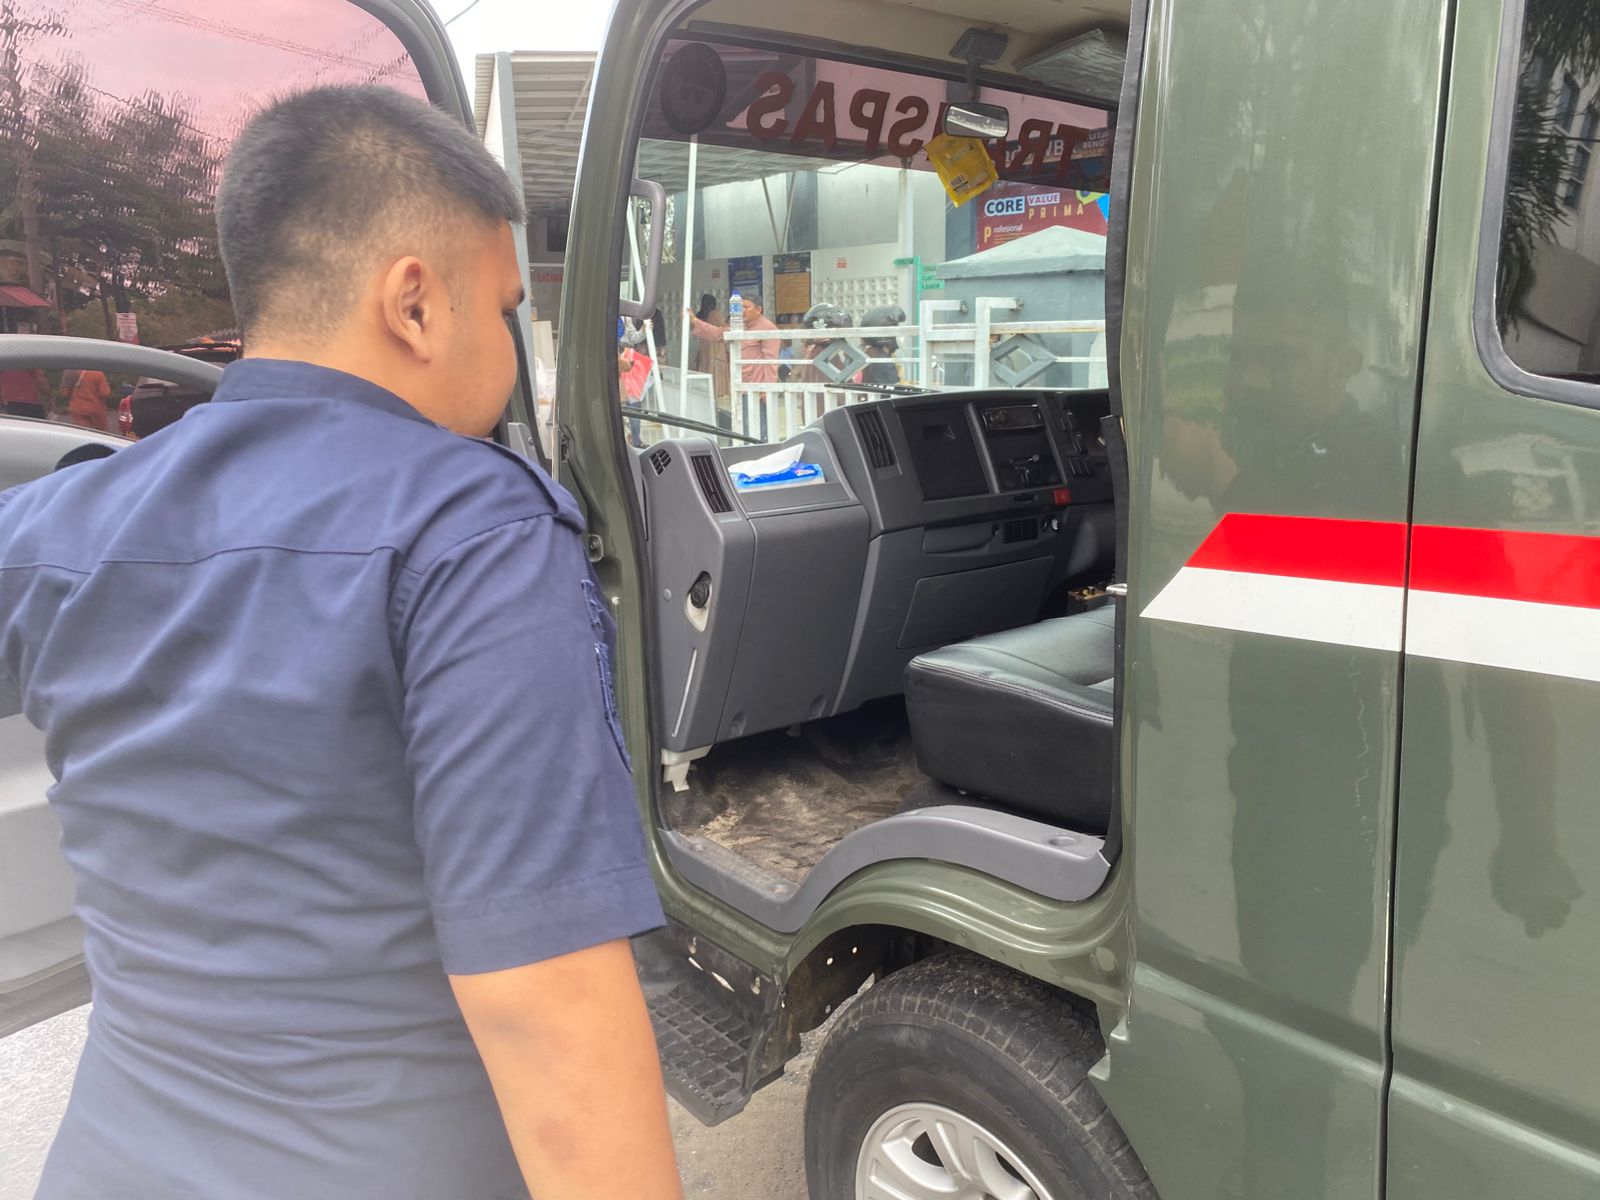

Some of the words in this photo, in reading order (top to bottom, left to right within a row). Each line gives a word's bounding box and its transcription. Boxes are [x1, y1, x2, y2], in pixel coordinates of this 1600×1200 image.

[986, 198, 1023, 215] CORE
[1027, 193, 1060, 206] VALUE
[1028, 203, 1084, 220] PRIMA
